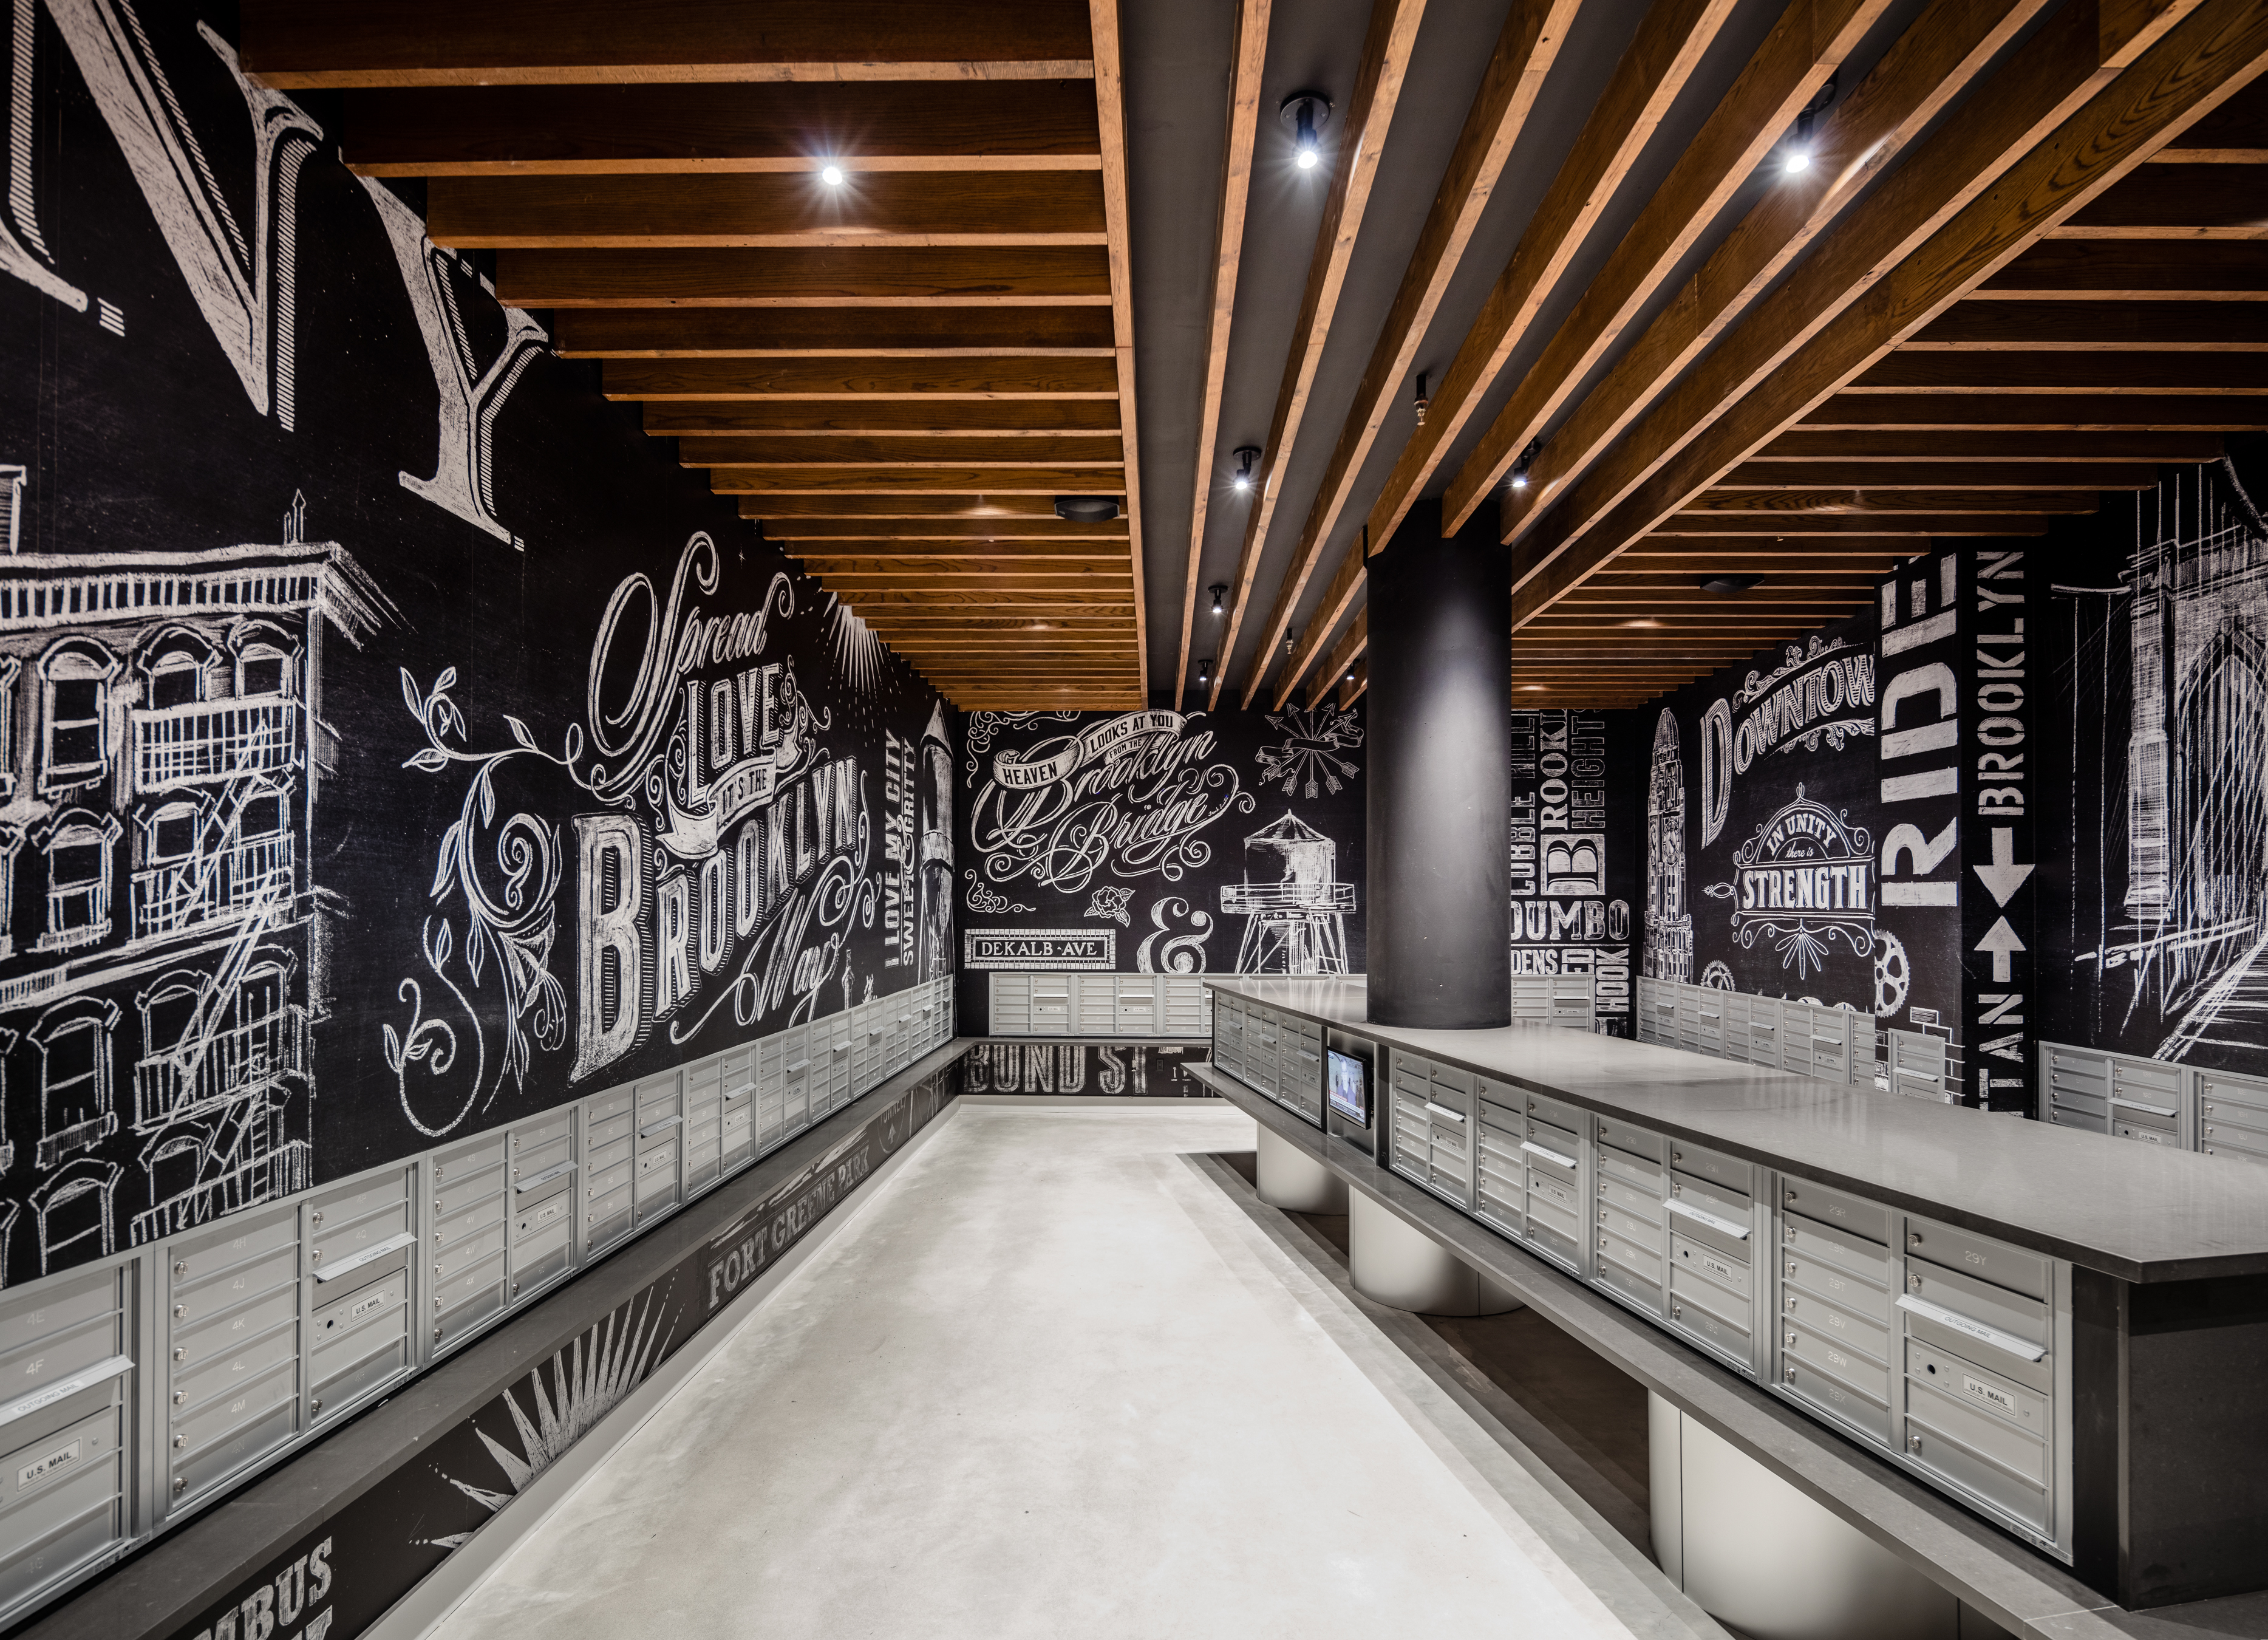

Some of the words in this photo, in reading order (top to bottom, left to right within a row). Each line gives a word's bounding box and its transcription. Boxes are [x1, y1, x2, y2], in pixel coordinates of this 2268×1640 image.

[587, 531, 794, 796] Spread
[1976, 552, 2025, 816] BROOKLYN
[686, 663, 783, 808] LOVE
[1090, 722, 1128, 754] LOOKS
[1132, 716, 1145, 731] AT
[1152, 715, 1173, 728] YOU
[1881, 553, 1958, 907] RIDE
[1109, 743, 1127, 759] FROM
[1129, 739, 1142, 749] THE
[885, 728, 901, 803] CITY
[1003, 761, 1057, 785] HEAVEN
[1571, 709, 1605, 828] HEIGHT
[722, 777, 745, 815] IT'S
[749, 768, 766, 794] THE
[972, 729, 1217, 853] Brooklyn
[885, 809, 899, 860] MY
[1038, 781, 1210, 893] Bridge
[1766, 824, 1785, 855] IN
[1786, 813, 1837, 848] UNITY
[1785, 841, 1806, 859] there
[1806, 849, 1814, 857] is
[1742, 865, 1867, 911] STRENGTH
[885, 870, 900, 946] LOVE
[569, 755, 857, 1087] BROOKLYN
[981, 941, 1053, 956] DEKALB
[1063, 941, 1097, 956] AVE
[1596, 948, 1629, 1011] HOOK
[467, 1215, 475, 1224] 4V
[1829, 1204, 1846, 1218] 29R
[356, 1229, 366, 1239] 4Q
[709, 1226, 768, 1310] FORT
[771, 1177, 835, 1252] GREENE
[837, 1145, 870, 1197] PARK
[233, 1237, 246, 1249] 4H
[466, 1246, 475, 1255] 4W
[359, 1251, 381, 1262] OUTGOING
[381, 1246, 390, 1254] MAIL
[1965, 1251, 1987, 1266] 29Y
[1707, 1261, 1716, 1270] U.S.
[1717, 1265, 1728, 1276] MAIL
[233, 1278, 244, 1290] 4J
[466, 1277, 475, 1286] 4X
[1829, 1277, 1845, 1291] 29T
[356, 1305, 367, 1314] U.S.
[368, 1298, 380, 1308] MAIL
[27, 1310, 45, 1325] 4E
[232, 1318, 245, 1331] 4K
[1829, 1314, 1846, 1329] 29V
[1944, 1316, 1976, 1332] OUTGOING
[1976, 1328, 1992, 1338] MAIL
[1705, 1322, 1718, 1335] 29Q
[26, 1359, 44, 1375] 4F
[232, 1360, 245, 1372] 4L
[1828, 1351, 1847, 1367] 29W
[18, 1390, 60, 1412] OUTGOING
[60, 1383, 79, 1396] MAIL
[1829, 1389, 1846, 1404] 29X
[1970, 1383, 1984, 1395] U.S.
[1987, 1391, 2007, 1406] MAIL
[231, 1399, 245, 1413] 4M
[27, 1465, 46, 1480] U.S.
[49, 1452, 72, 1469] MAIL
